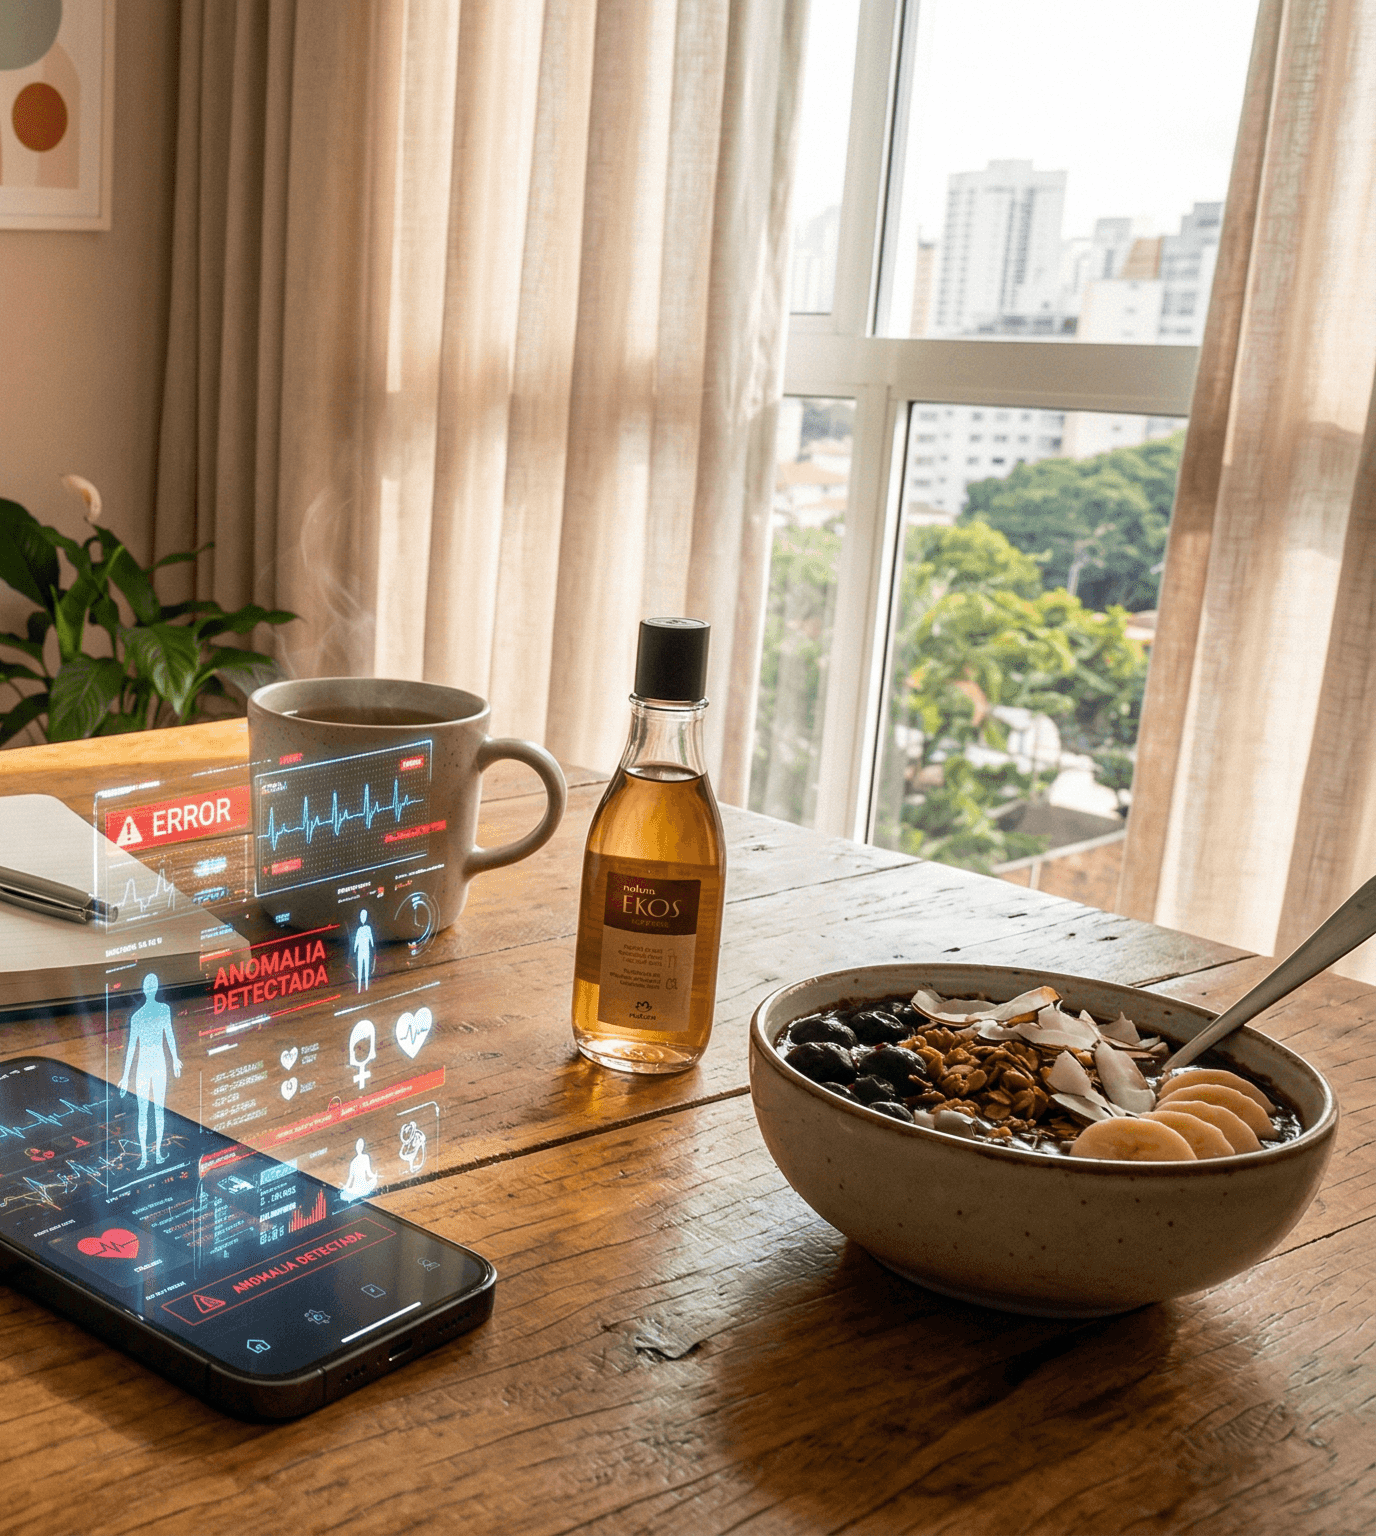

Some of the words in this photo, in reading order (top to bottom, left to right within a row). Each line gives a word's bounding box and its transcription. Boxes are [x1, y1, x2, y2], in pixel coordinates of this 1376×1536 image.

[152, 797, 232, 838] ERROR
[622, 894, 682, 918] EKOS
[213, 940, 326, 990] ANOMALIA
[213, 964, 329, 1015] DETECTADA
